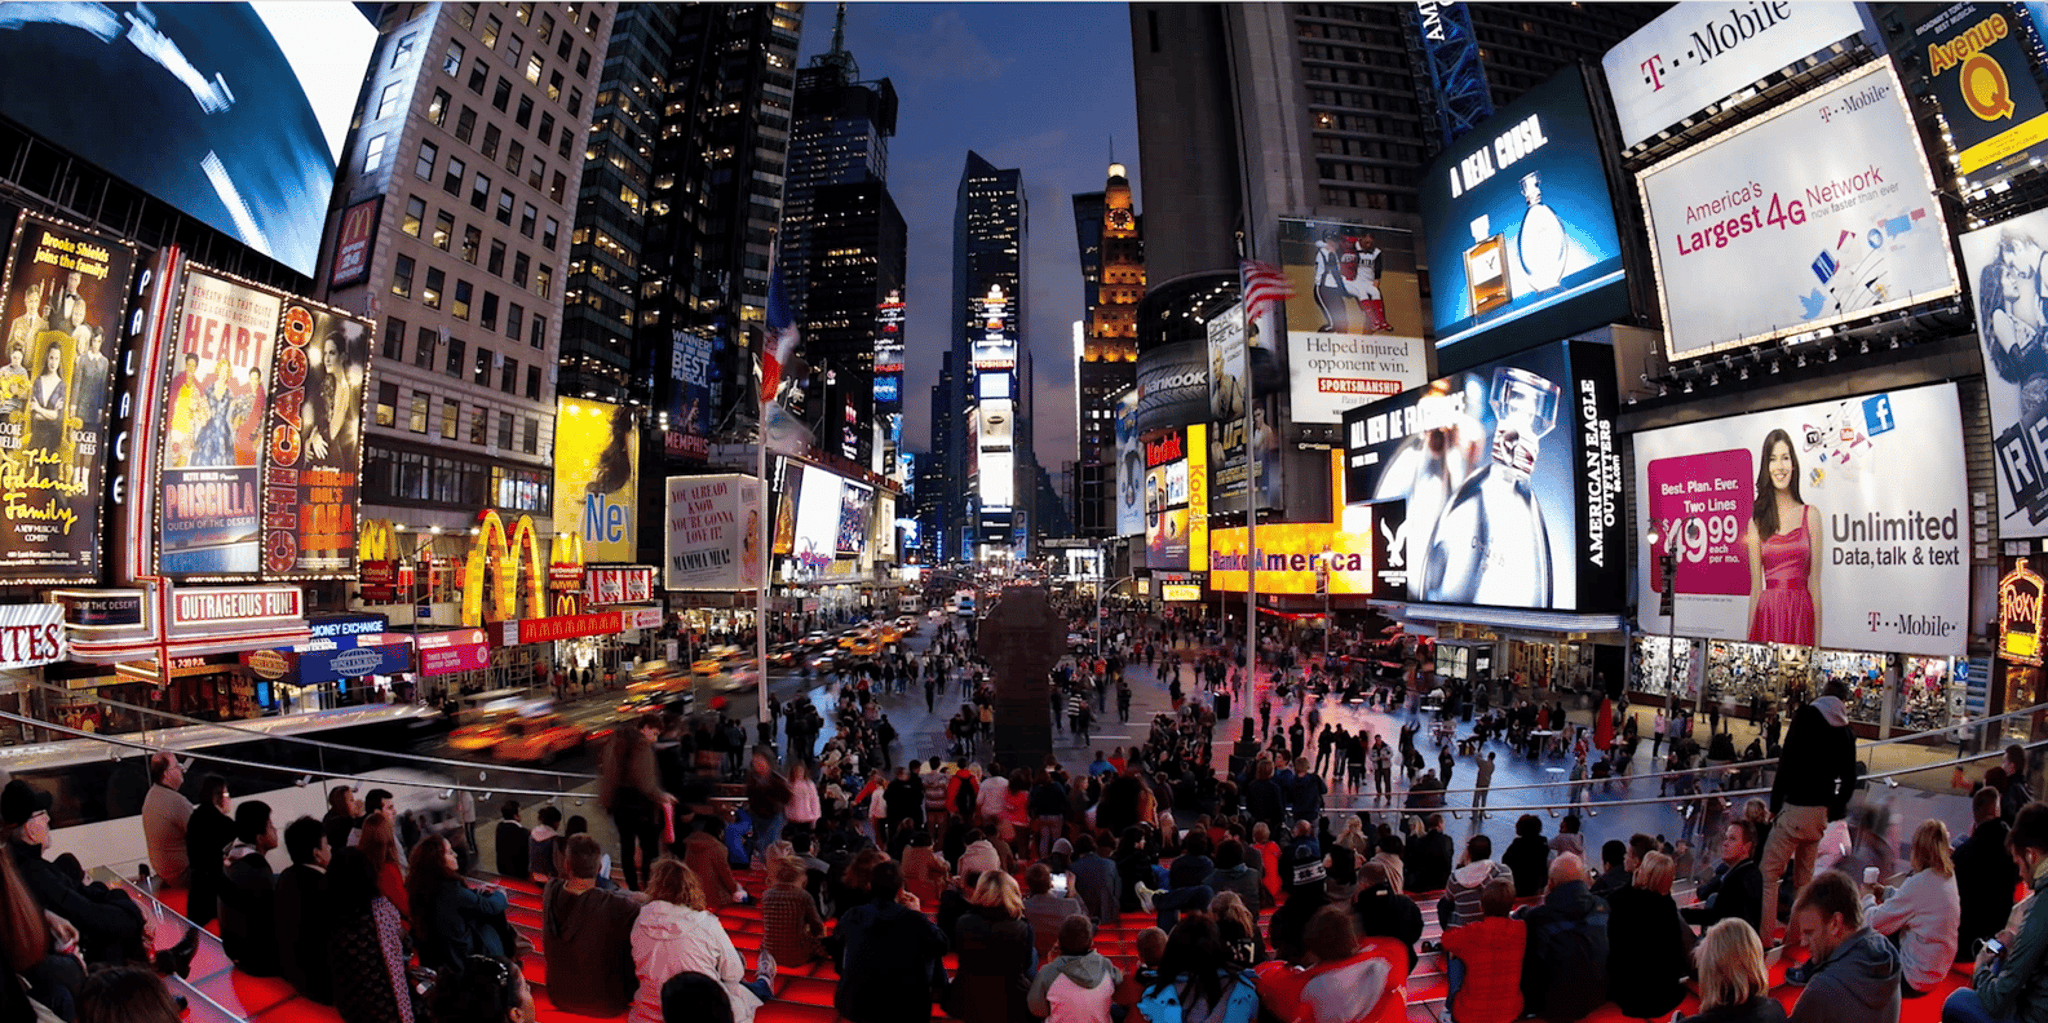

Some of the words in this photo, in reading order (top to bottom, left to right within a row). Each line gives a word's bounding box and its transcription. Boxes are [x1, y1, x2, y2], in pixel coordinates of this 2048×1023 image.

[1928, 13, 2009, 77] Avenue
[1960, 52, 2016, 121] Q
[1450, 166, 1463, 199] A
[1461, 145, 1496, 191] REAL
[1805, 164, 1884, 208] Network
[1686, 180, 1763, 225] America's
[1830, 196, 1857, 214] faster
[1858, 188, 1879, 206] than
[1879, 182, 1900, 197] ever
[1676, 204, 1763, 256] Largest
[1767, 192, 1806, 231] 4G
[41, 231, 76, 254] Brooke
[75, 241, 110, 263] Shields
[33, 246, 59, 265] joins
[59, 253, 76, 270] the
[75, 257, 110, 281] family!
[182, 313, 267, 369] HEART
[1306, 337, 1358, 357] Helped
[1361, 339, 1409, 357] injured
[671, 367, 709, 389] MUSICAL
[672, 349, 710, 377] BEST
[976, 359, 1015, 369] TOSHIBA
[1308, 358, 1376, 374] opponent
[1379, 358, 1409, 373] win.
[114, 269, 151, 505] PALACE
[1320, 379, 1401, 394] SPORTSMANSHIP
[1580, 379, 1600, 448] EAGLE
[266, 305, 314, 573] CHICAGO
[664, 430, 709, 455] MEMPHIS
[22, 447, 62, 468] The
[0, 452, 86, 497] Addams
[1599, 419, 1616, 528] OUTFITTERS
[1661, 482, 1686, 496] Best.
[1687, 480, 1713, 494] Plan.
[1714, 477, 1739, 491] Ever.
[165, 481, 257, 520] PRISCILLA
[687, 499, 714, 515] KNOW
[1190, 464, 1206, 533] Kodak
[1587, 450, 1604, 568] AMERICAN
[1683, 499, 1706, 513] Two
[1707, 498, 1738, 512] Lines
[3, 492, 79, 536] Family
[166, 520, 196, 532] QUEEN
[209, 518, 225, 528] THE
[226, 516, 256, 528] DESERT
[1832, 507, 1959, 543] Unlimited
[685, 528, 707, 545] LOVE
[1708, 545, 1729, 554] each
[673, 552, 708, 572] MAMMA
[708, 548, 731, 565] MIA!
[1708, 555, 1723, 565] per
[1724, 555, 1740, 564] mo.
[1912, 546, 1925, 566] &
[1928, 545, 1960, 566] text
[91, 601, 107, 610] THE
[108, 600, 138, 610] DESERT
[181, 593, 262, 620] OUTRAGEOUS
[265, 592, 293, 616] FUN!
[342, 620, 383, 635] EXCHANGE
